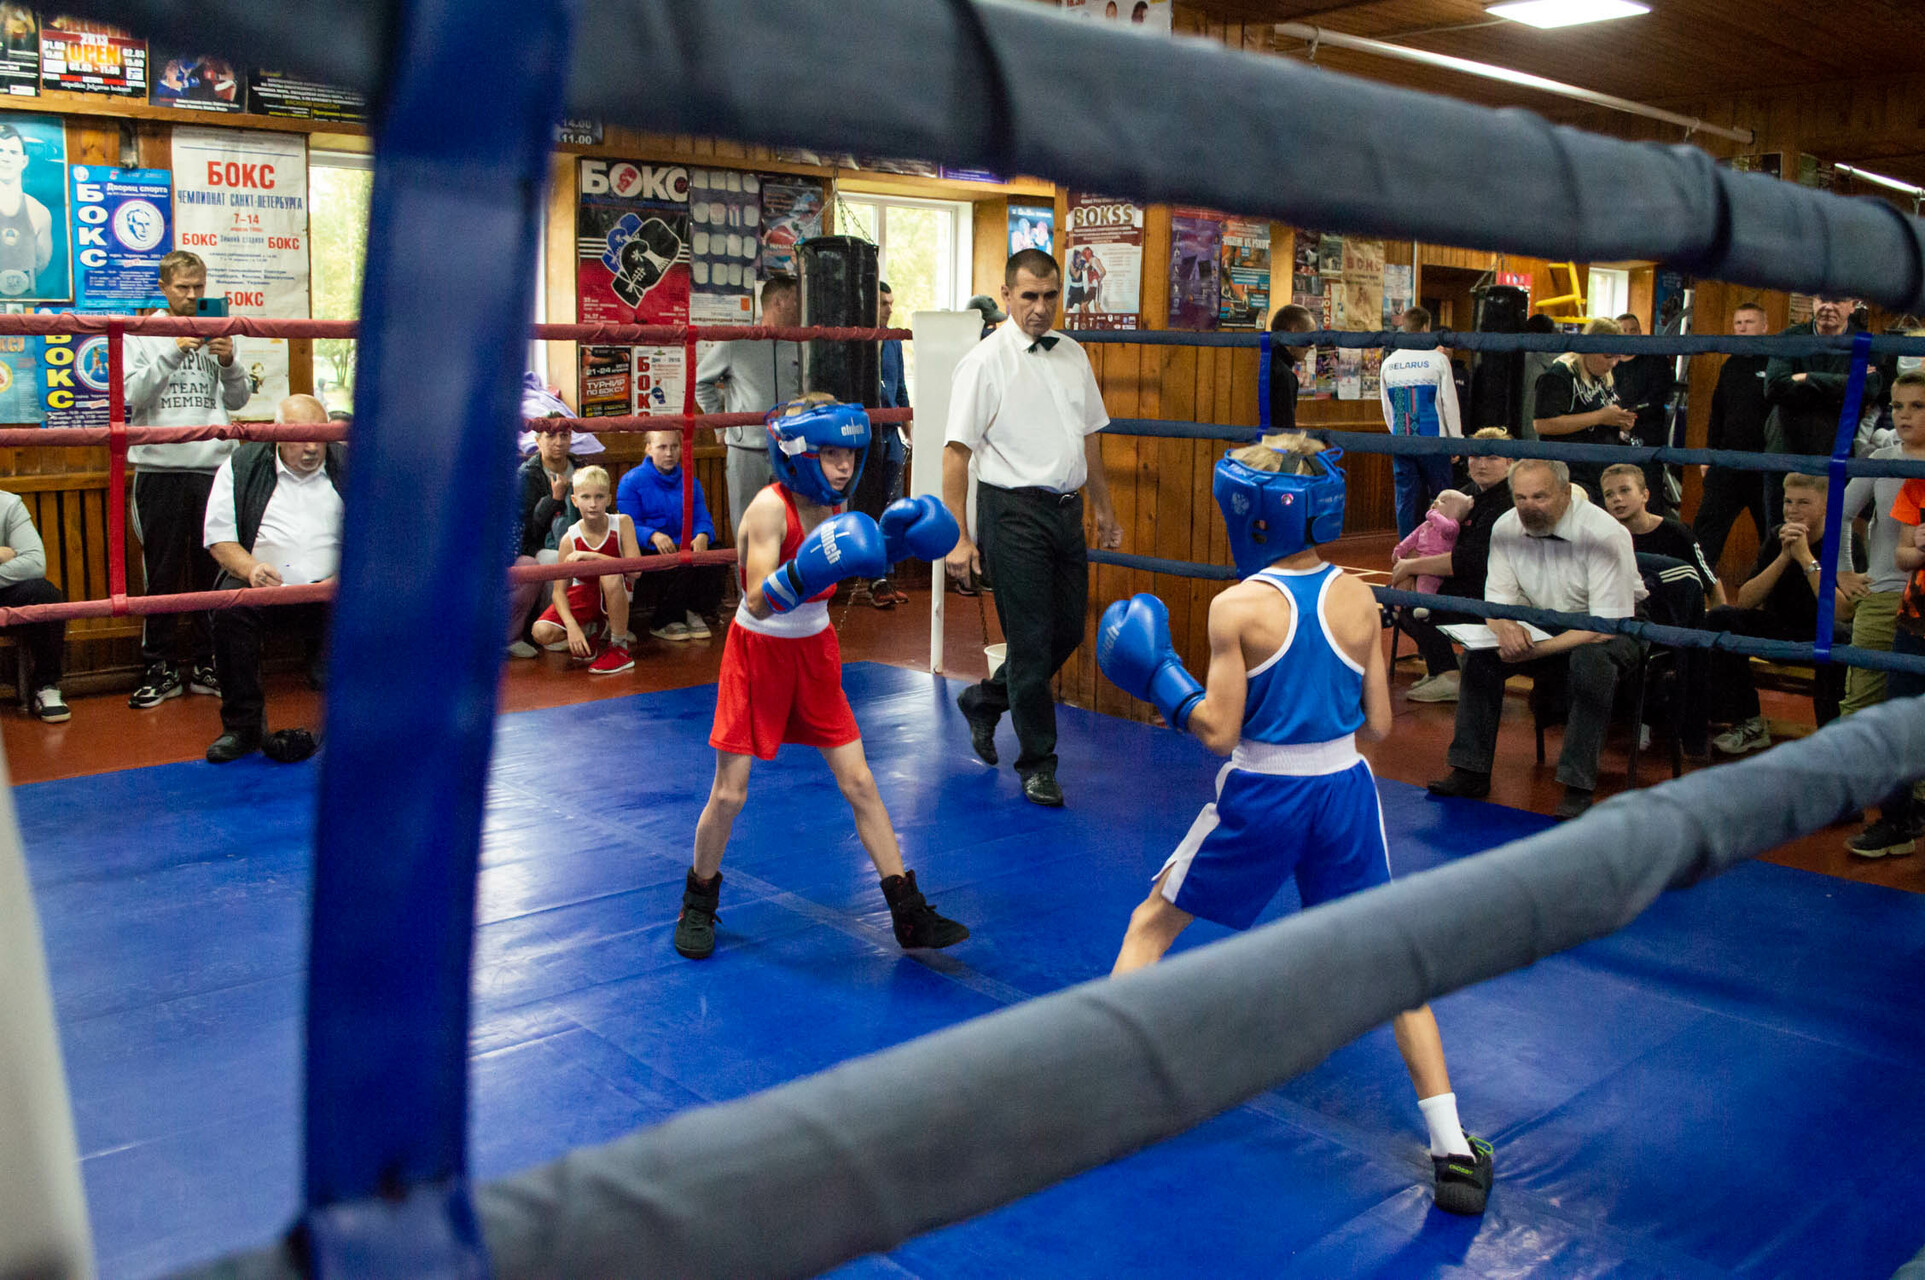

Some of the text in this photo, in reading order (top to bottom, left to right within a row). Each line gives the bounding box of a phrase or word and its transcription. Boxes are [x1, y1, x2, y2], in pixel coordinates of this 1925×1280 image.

[68, 43, 121, 65] OPEN
[561, 134, 592, 145] 11.00
[206, 160, 276, 189] БОКС
[581, 160, 689, 202] БОКС
[139, 186, 169, 195] спорта
[177, 190, 226, 206] ЧЕМПИОНАТ
[230, 193, 303, 210] САНКТ-ПЕТЕРБУРГА
[1073, 204, 1134, 227] BOKSS
[76, 183, 109, 268] БОКС
[182, 233, 218, 247] БОКС
[267, 236, 300, 250] БОКС
[224, 291, 264, 307] БОКС
[1388, 360, 1430, 371] BELARUS
[169, 381, 209, 395] TEAM
[586, 379, 626, 390] ТУРНИР
[586, 386, 625, 397] ПО БОКСУ
[160, 396, 217, 410] MEMBER
